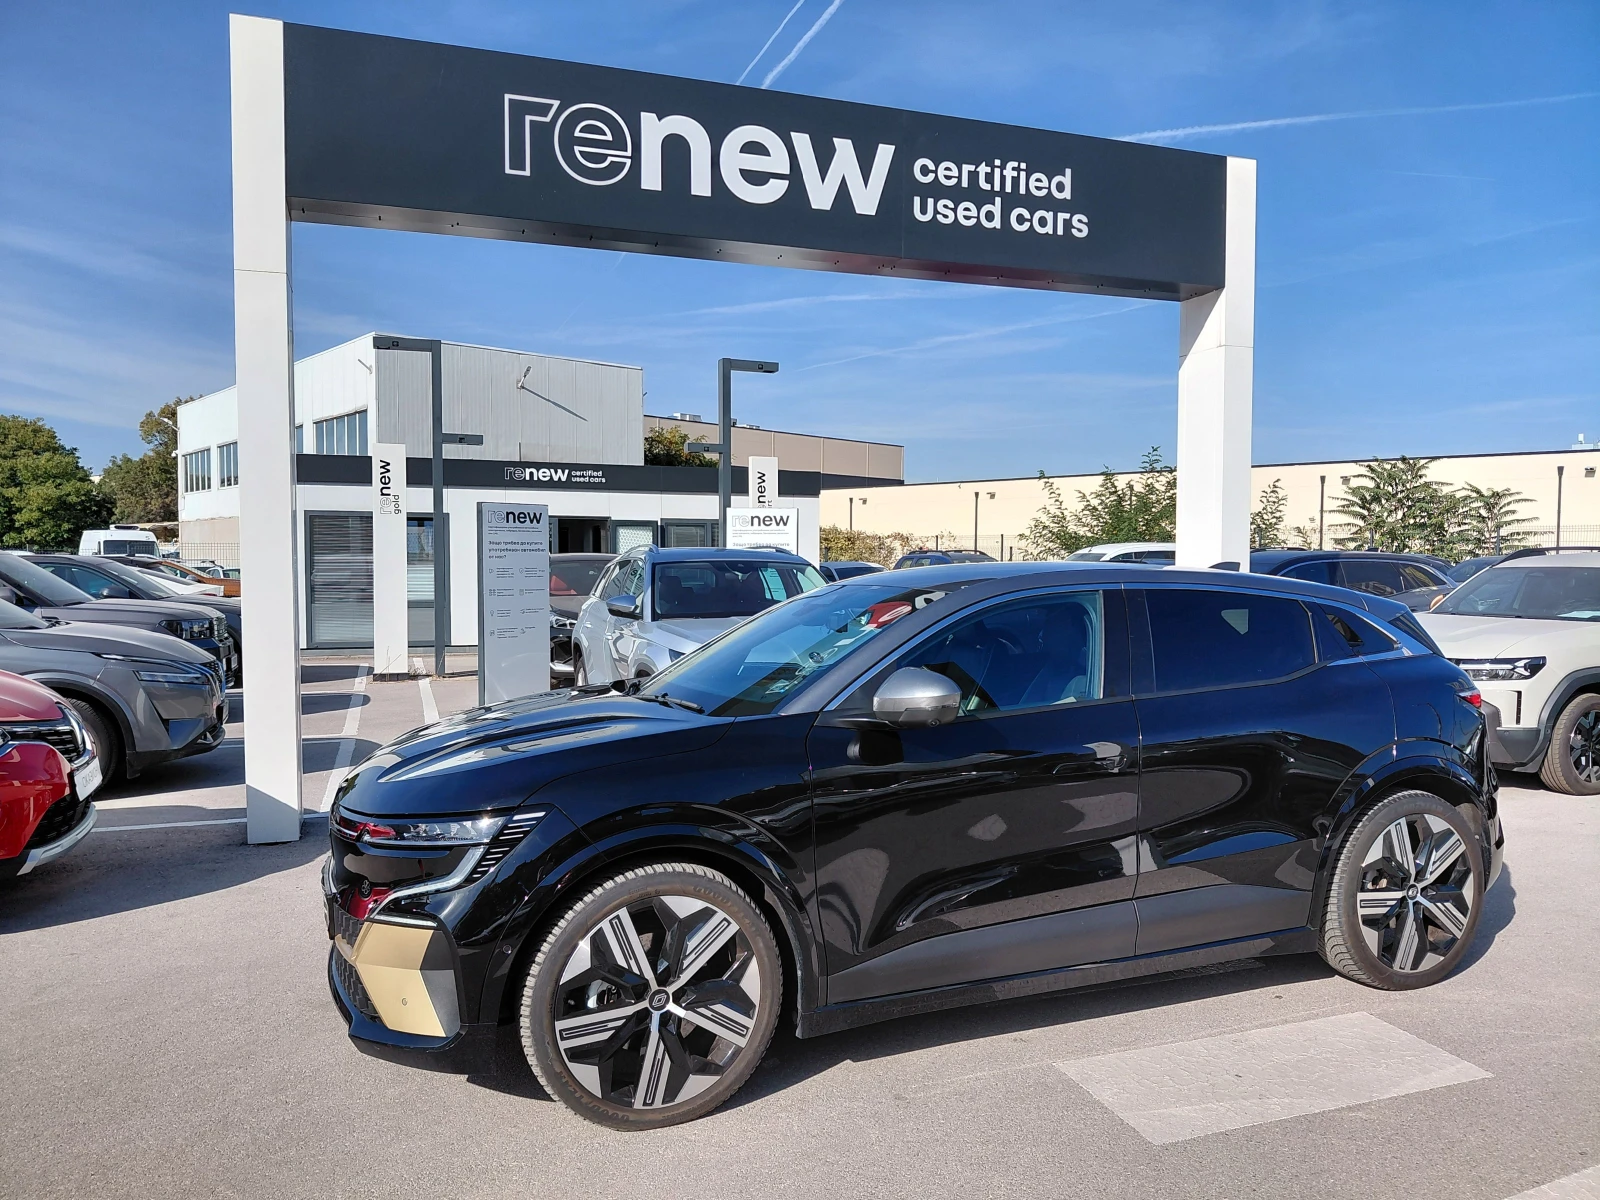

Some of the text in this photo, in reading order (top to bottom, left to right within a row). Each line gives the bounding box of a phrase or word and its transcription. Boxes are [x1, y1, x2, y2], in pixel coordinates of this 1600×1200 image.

[504, 93, 896, 217] renew
[913, 157, 1072, 200] certified
[913, 196, 1089, 238] used cars
[379, 459, 392, 515] renew
[504, 466, 569, 482] renew
[392, 494, 402, 515] gold
[487, 510, 543, 525] renew
[731, 514, 790, 528] renew
